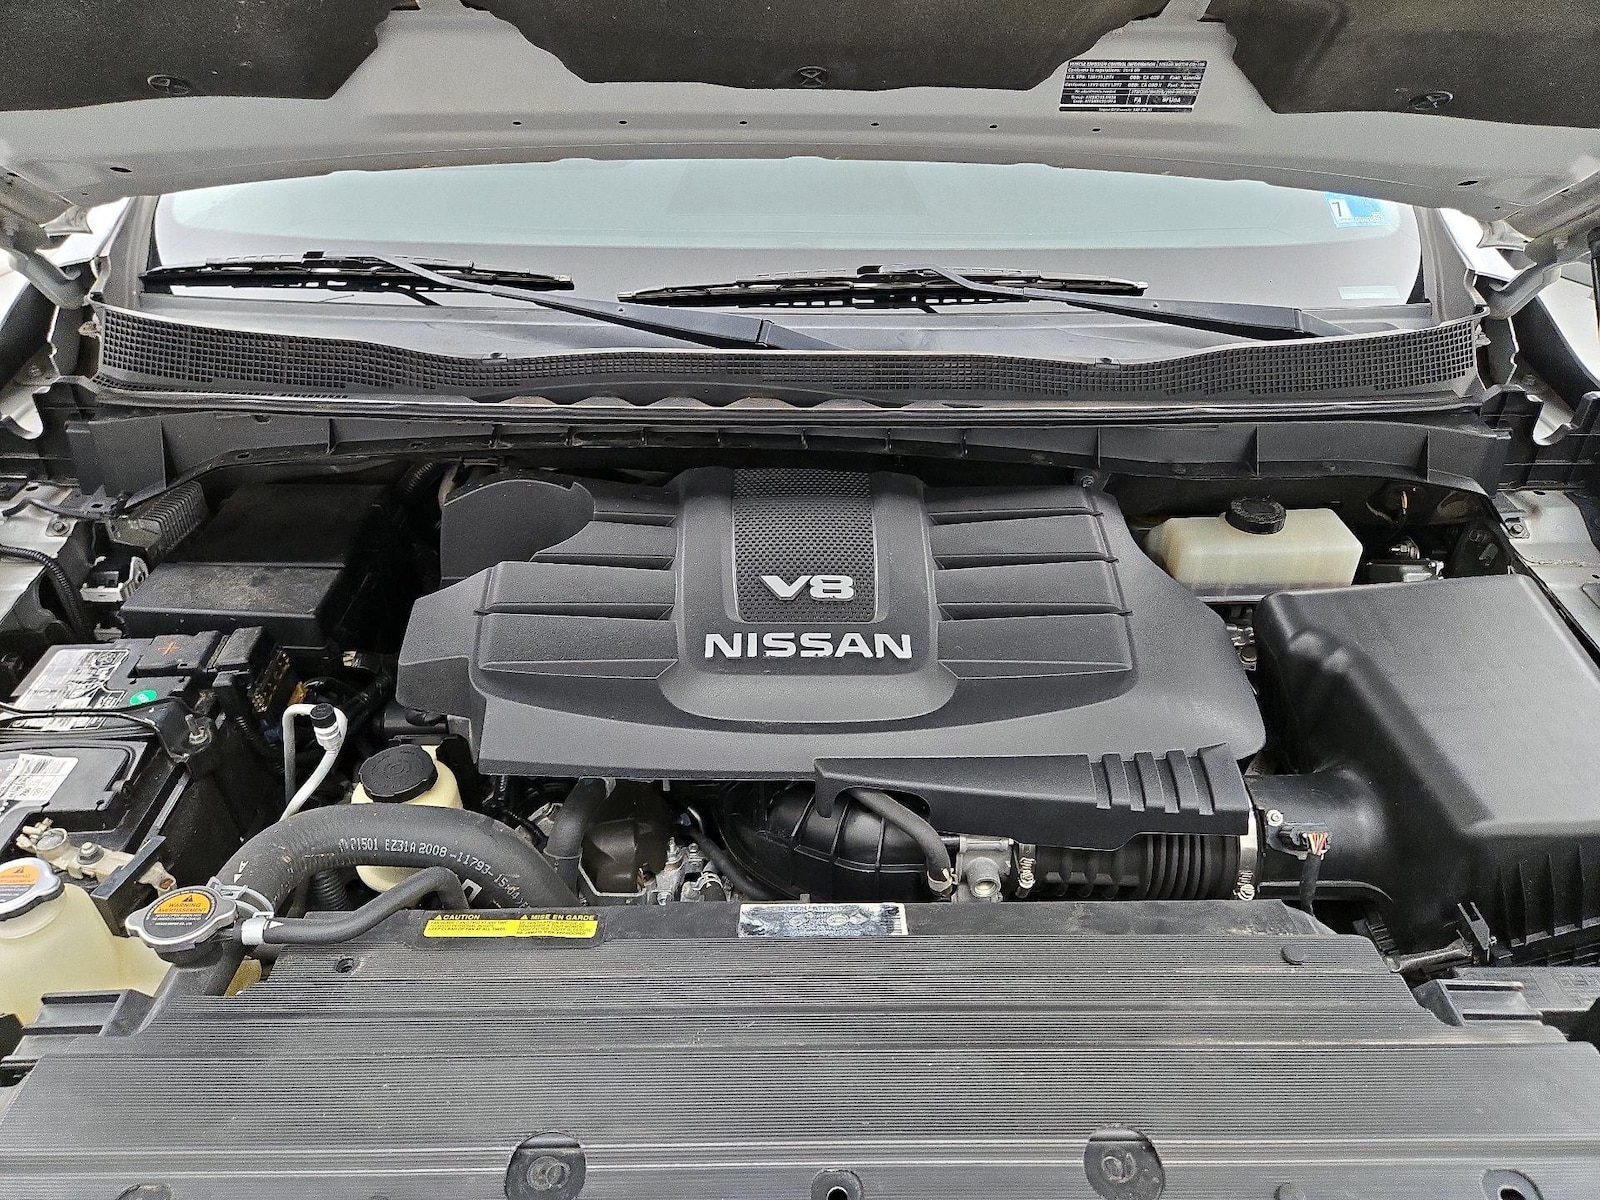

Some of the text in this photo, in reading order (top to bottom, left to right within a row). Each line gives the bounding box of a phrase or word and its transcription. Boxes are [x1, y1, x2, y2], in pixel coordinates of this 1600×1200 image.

[760, 574, 856, 602] V8
[704, 632, 913, 660] NISSAN
[385, 838, 416, 853] EZ31A
[418, 842, 448, 858] 2008
